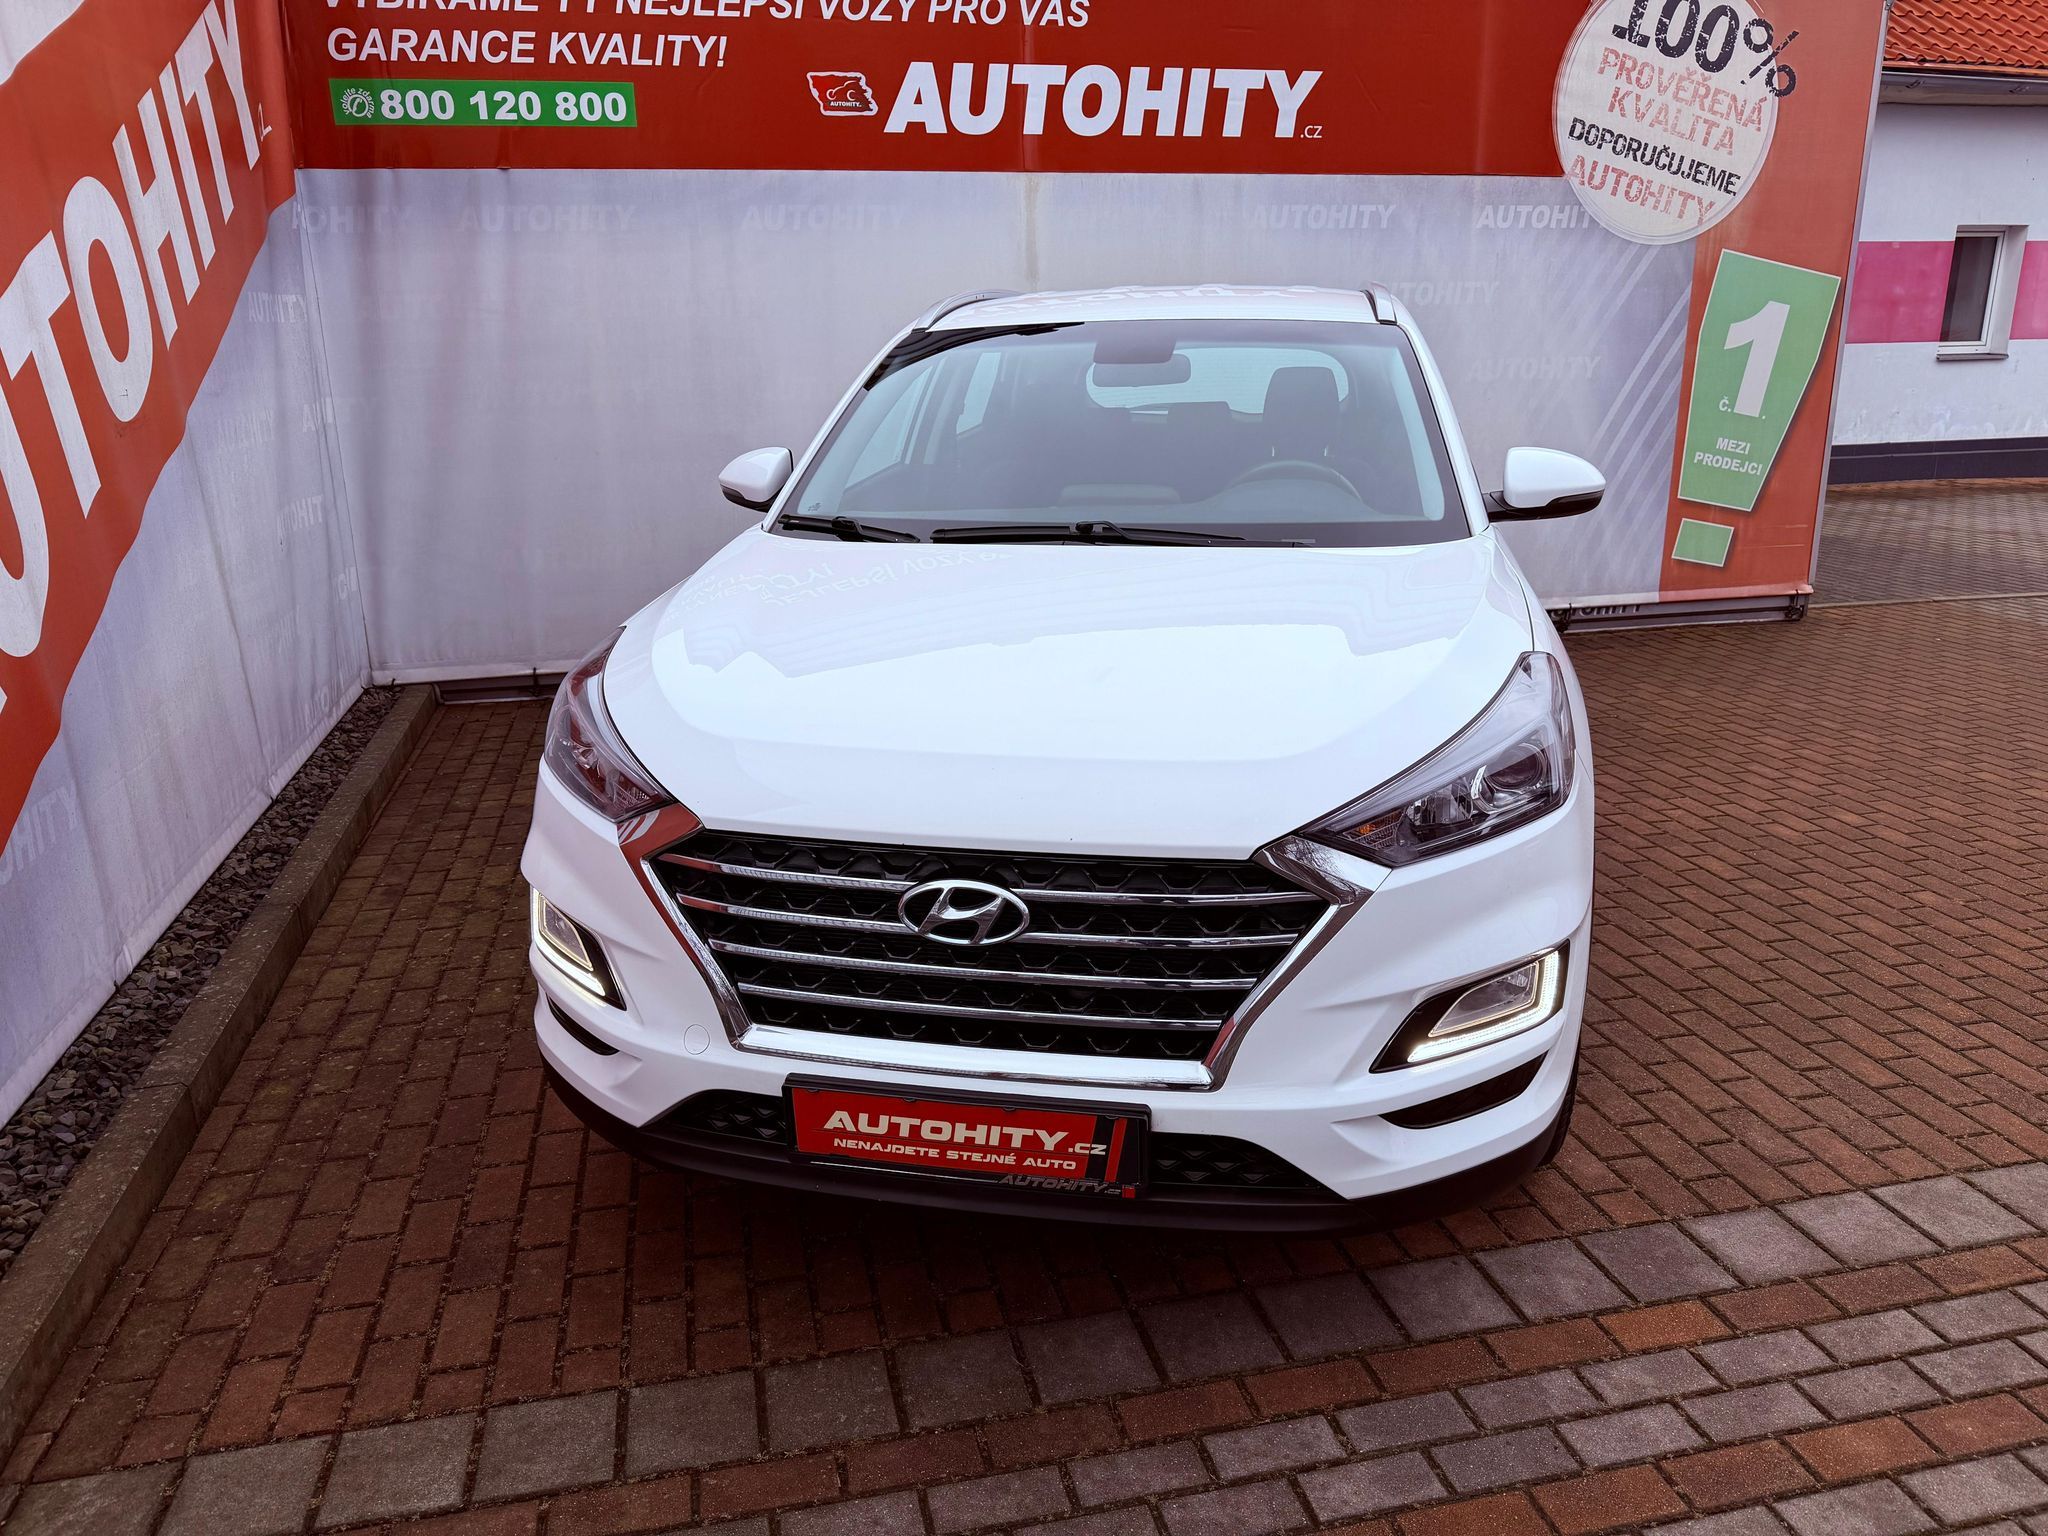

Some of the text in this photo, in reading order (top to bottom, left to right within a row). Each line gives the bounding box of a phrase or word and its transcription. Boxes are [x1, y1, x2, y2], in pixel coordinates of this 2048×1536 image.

[928, 0, 1006, 24] PRO
[328, 28, 727, 66] GARANCE KVALITY!
[1612, 0, 1799, 97] 100%
[381, 90, 626, 121] 800 120 800
[1597, 47, 1767, 130] PROVĚŘENÁ
[1607, 86, 1734, 155] KVALITA
[1568, 117, 1741, 196] DOPORUČUJEME
[1565, 155, 1715, 226] AUTOHITY
[1716, 437, 1751, 454] MEZI
[833, 1138, 1076, 1170] NENAJDETE STEJNÉ AUTO
